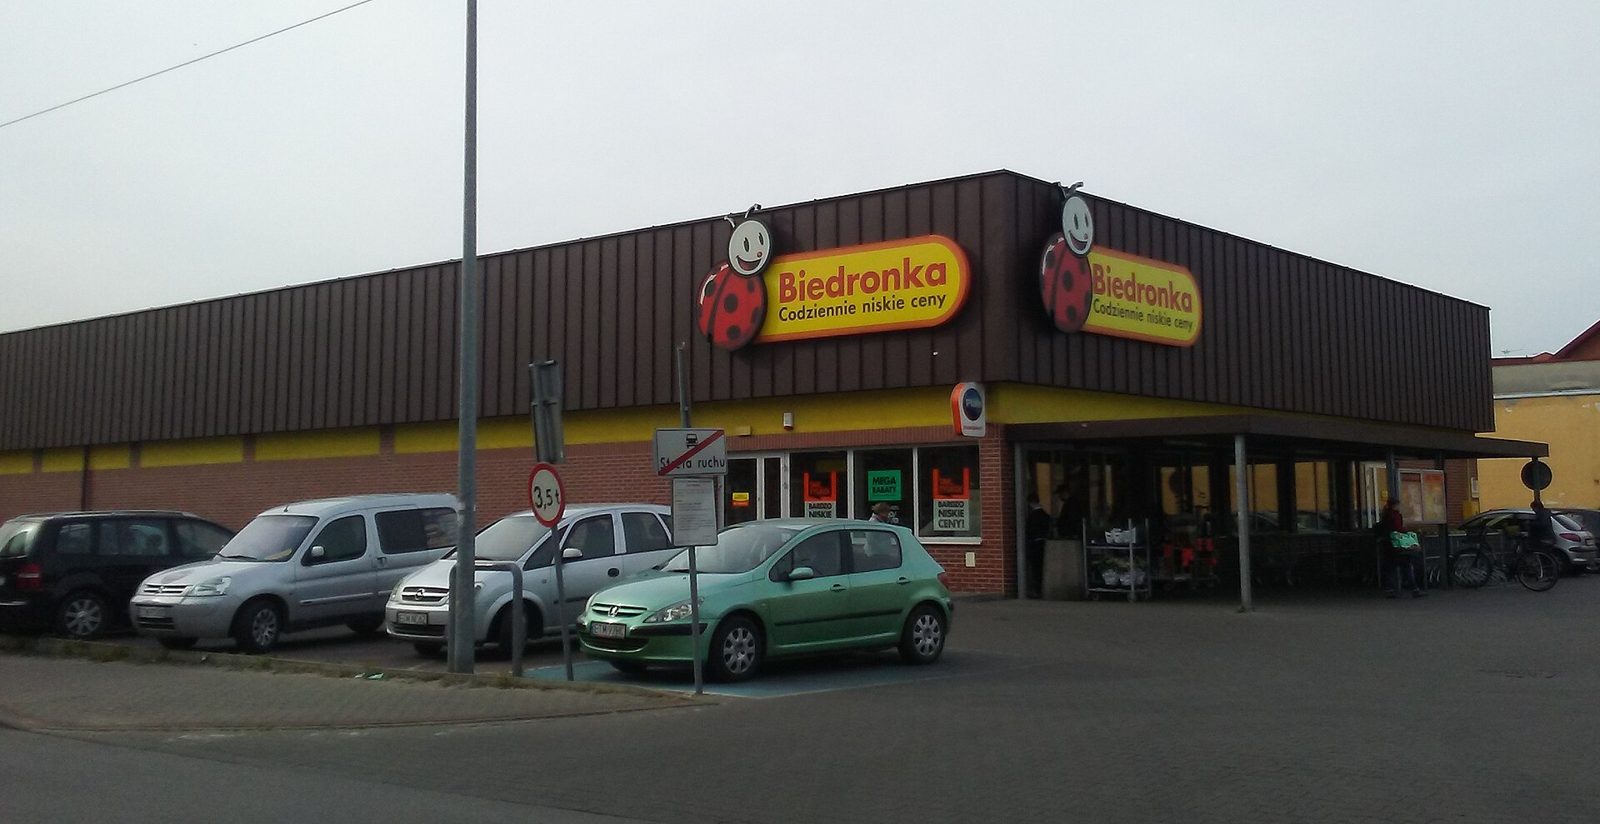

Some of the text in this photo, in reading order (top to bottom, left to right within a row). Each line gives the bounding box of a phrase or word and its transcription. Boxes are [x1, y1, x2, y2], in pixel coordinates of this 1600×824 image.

[779, 257, 947, 304] Biedronka
[1092, 263, 1193, 313] Biedronka
[778, 294, 947, 322] Codziennie niskie ceny
[1093, 298, 1194, 333] Codziennie niskie ceny
[660, 455, 725, 469] Sta ruchu
[872, 476, 897, 485] MEGA
[808, 510, 833, 518] NISKIE
[938, 509, 965, 518] NISKIE
